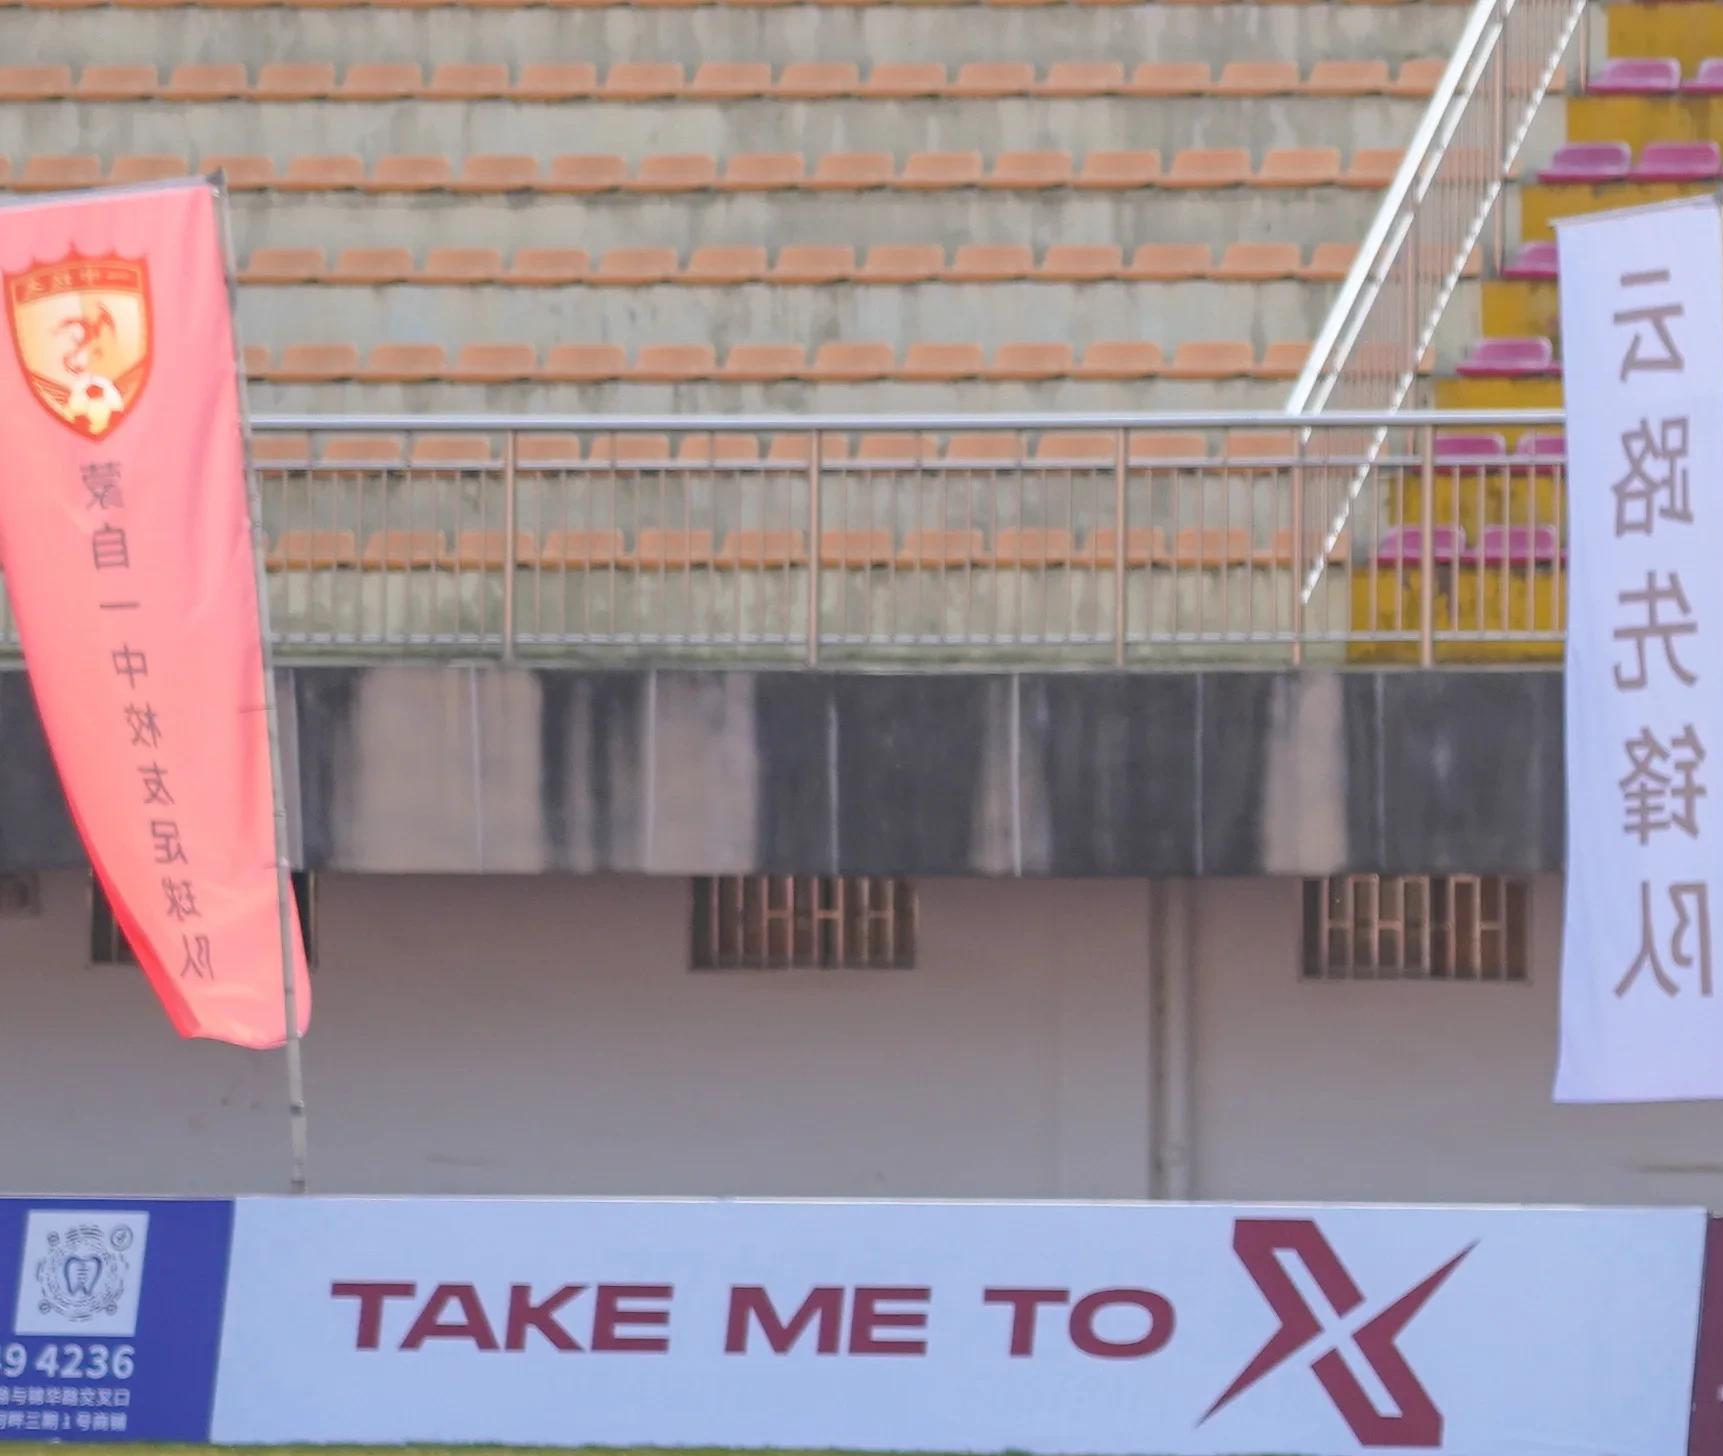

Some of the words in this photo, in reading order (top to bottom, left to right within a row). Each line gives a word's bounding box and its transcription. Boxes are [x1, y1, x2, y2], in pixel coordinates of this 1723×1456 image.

[330, 1280, 675, 1354] TAKE
[723, 1284, 932, 1357] ME
[983, 1286, 1177, 1360] TO
[0, 1343, 27, 1378] 9
[35, 1344, 136, 1380] 4236
